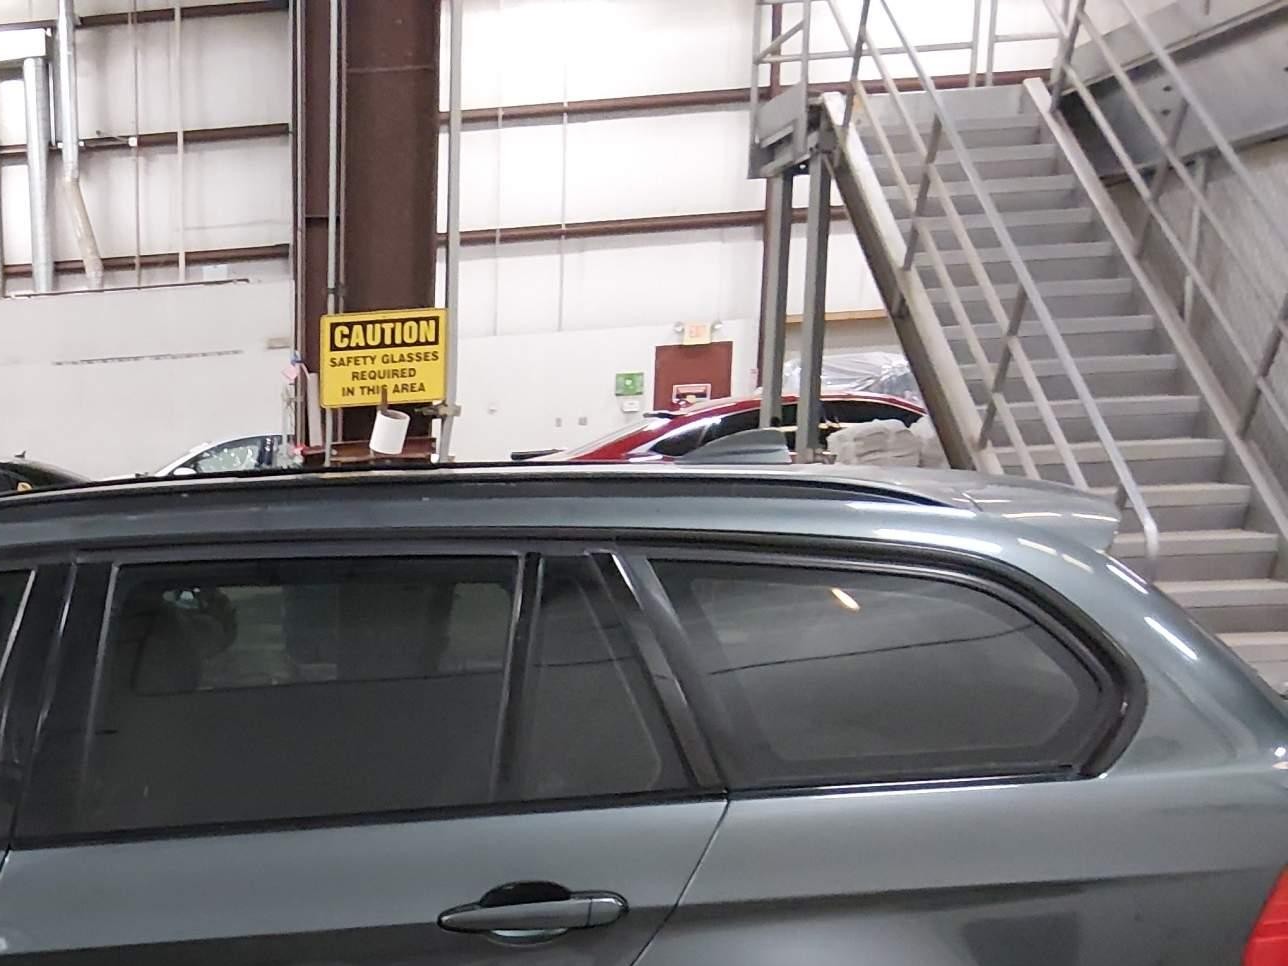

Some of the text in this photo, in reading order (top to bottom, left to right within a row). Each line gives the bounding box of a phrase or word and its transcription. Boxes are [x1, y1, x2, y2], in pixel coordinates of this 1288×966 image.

[334, 320, 436, 348] CAUTION
[330, 351, 439, 368] SAFETY GLASSES
[352, 368, 417, 381] REQUIRED
[342, 387, 355, 397] IN
[392, 383, 426, 394] AREA
